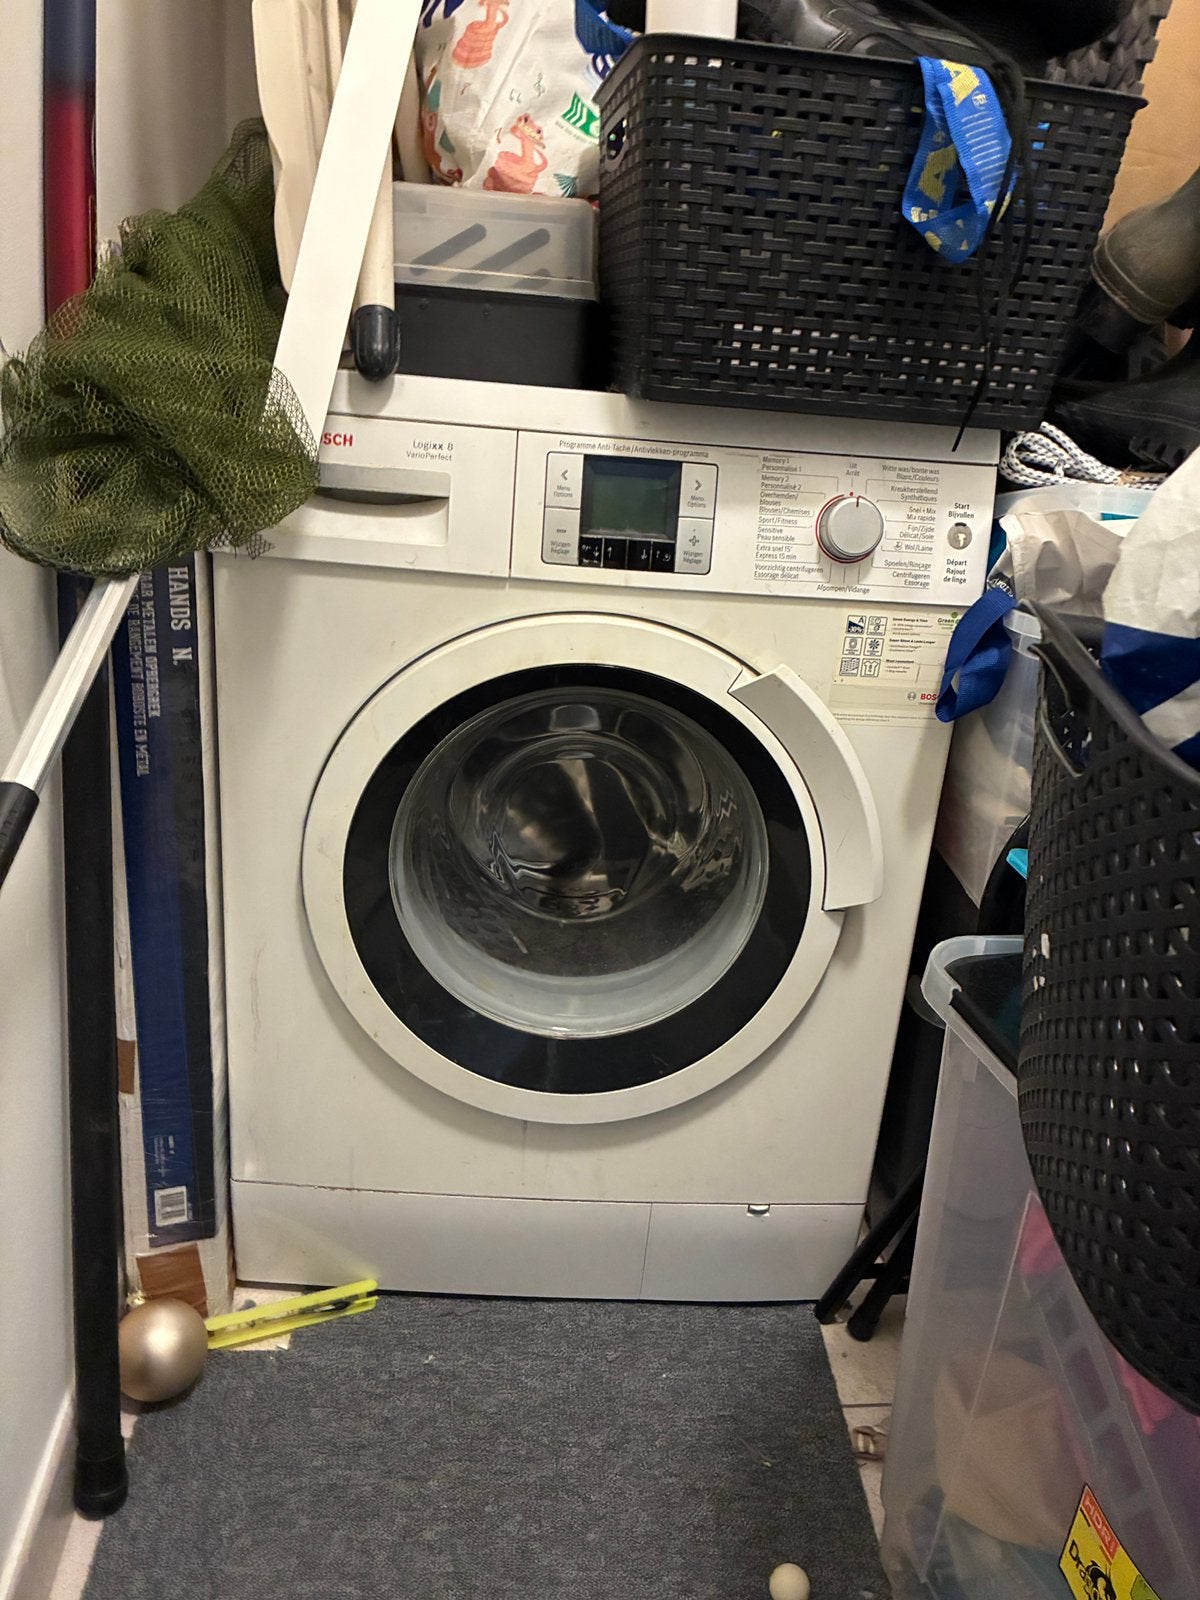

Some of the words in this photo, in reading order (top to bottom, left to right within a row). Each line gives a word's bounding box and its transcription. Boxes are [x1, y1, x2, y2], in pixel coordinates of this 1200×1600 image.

[320, 432, 353, 447] SCH
[559, 439, 596, 449] Programme
[412, 440, 443, 451] Logixx
[406, 450, 452, 461] VarioPerfect
[762, 456, 785, 465] Memory
[761, 474, 784, 482] Memory
[896, 472, 939, 482] Blanc/Couleurs
[890, 485, 938, 495] Kreukherstellend
[760, 491, 799, 500] Overhemden/
[954, 502, 970, 510] Start
[948, 510, 975, 519] Bijvullen
[758, 516, 798, 525] Sport/Fitness
[757, 526, 783, 534] Sensitive
[907, 524, 935, 533] Fijn/Zijde
[756, 533, 771, 541] Peau
[771, 534, 795, 542] sensible
[904, 544, 934, 552] Wol/Laine
[755, 551, 778, 559] Express
[884, 560, 932, 569] Spoelen/Rinçage
[946, 558, 967, 566] Départ
[754, 562, 785, 572] Voorzichtig
[786, 565, 824, 574] centrifugeren
[946, 567, 966, 575] Rajout
[753, 571, 779, 580] Essorage
[892, 571, 931, 580] Centrifugeren
[951, 576, 967, 584] linge
[904, 579, 930, 588] Essorage
[816, 584, 870, 594] Afpompen/Vidange
[168, 567, 191, 630] HANDS
[142, 600, 157, 654] METALEN
[128, 617, 144, 680] RANGEMENT
[172, 647, 192, 666] N.
[145, 656, 160, 718] OPBERGREK
[920, 693, 937, 701] BOS
[131, 682, 147, 727] ROBUSTE
